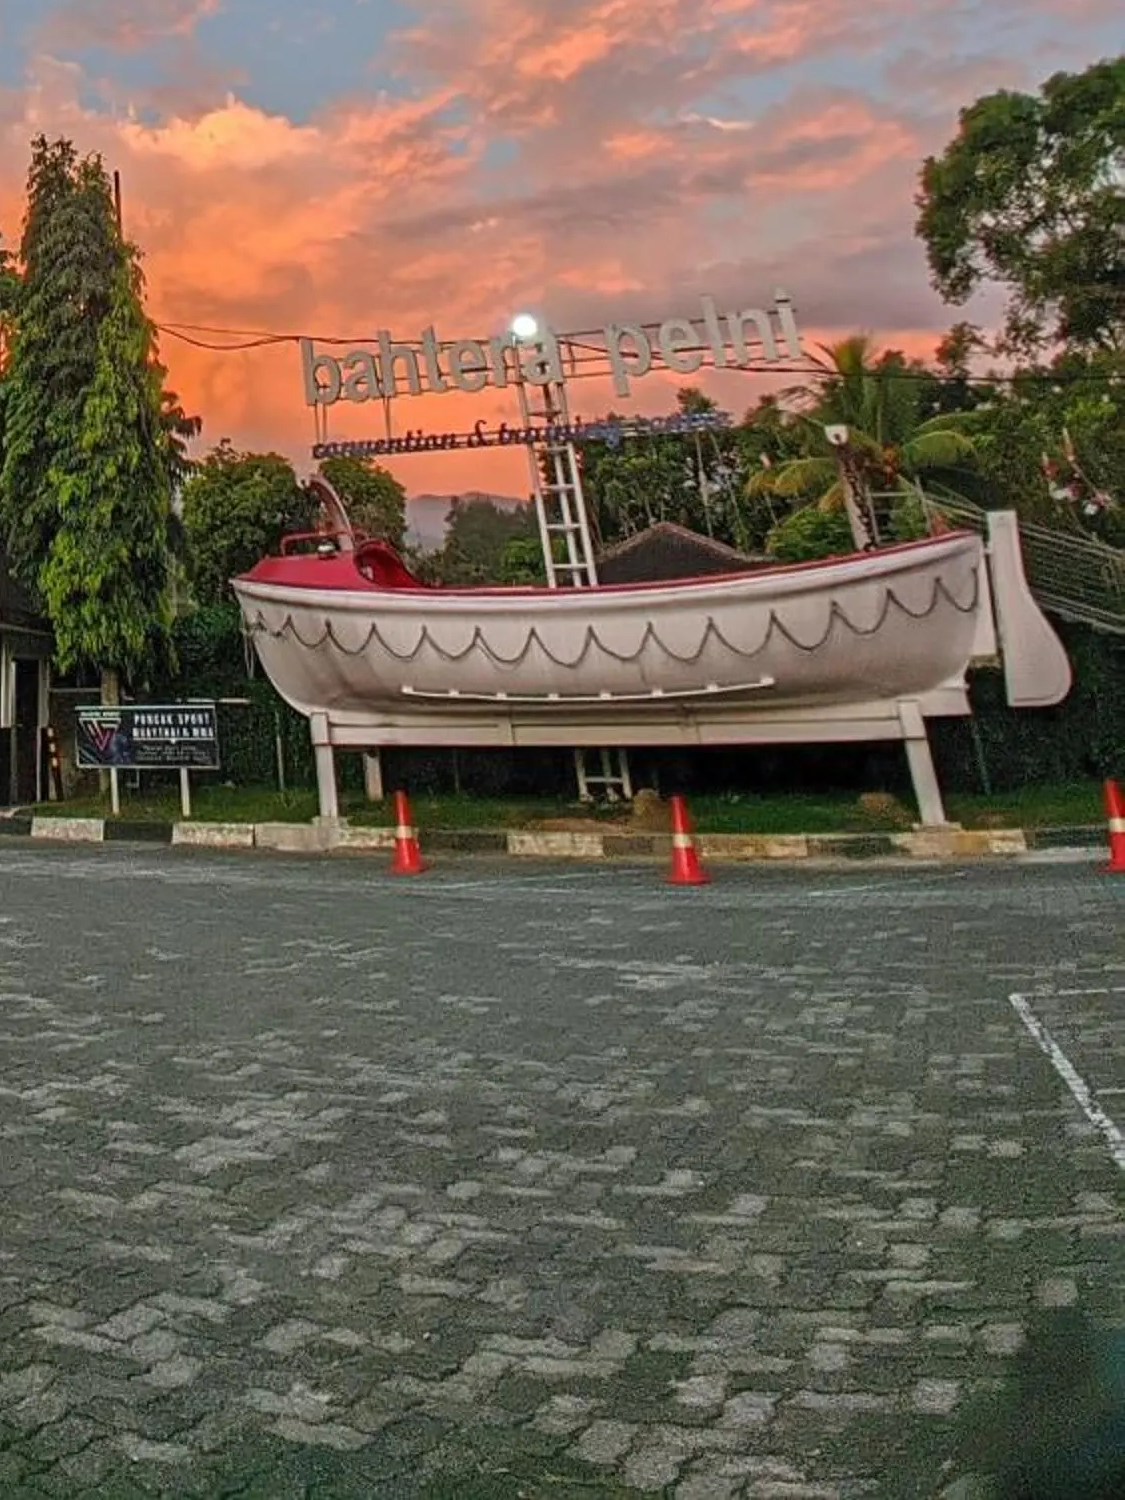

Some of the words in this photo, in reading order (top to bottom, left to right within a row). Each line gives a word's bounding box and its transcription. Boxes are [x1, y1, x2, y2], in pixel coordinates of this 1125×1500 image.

[299, 325, 564, 406] bahtera
[604, 287, 802, 397] pelni
[312, 429, 457, 459] convention
